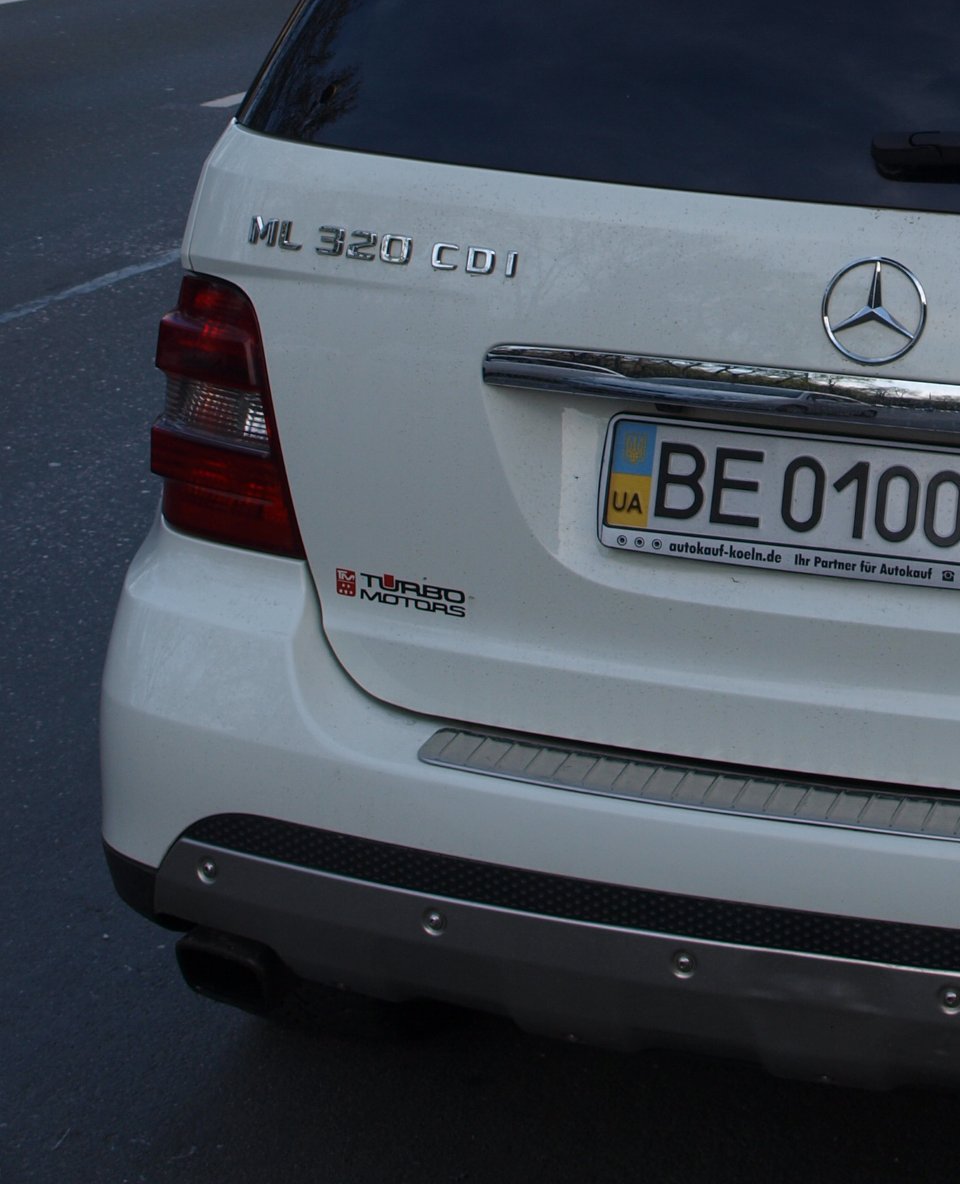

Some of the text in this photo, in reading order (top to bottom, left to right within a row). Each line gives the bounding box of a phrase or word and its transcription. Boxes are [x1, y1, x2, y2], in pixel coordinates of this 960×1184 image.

[248, 215, 519, 278] ML 320 CDI
[654, 441, 765, 528] BE
[612, 492, 643, 515] UA
[669, 541, 782, 564] autokauf-koeln.de
[794, 554, 811, 566] Ihr
[814, 556, 856, 572] Partner
[860, 561, 878, 574] für
[879, 561, 932, 580] Autokauf
[360, 572, 466, 604] TURBO
[360, 589, 466, 618] MOTORS
